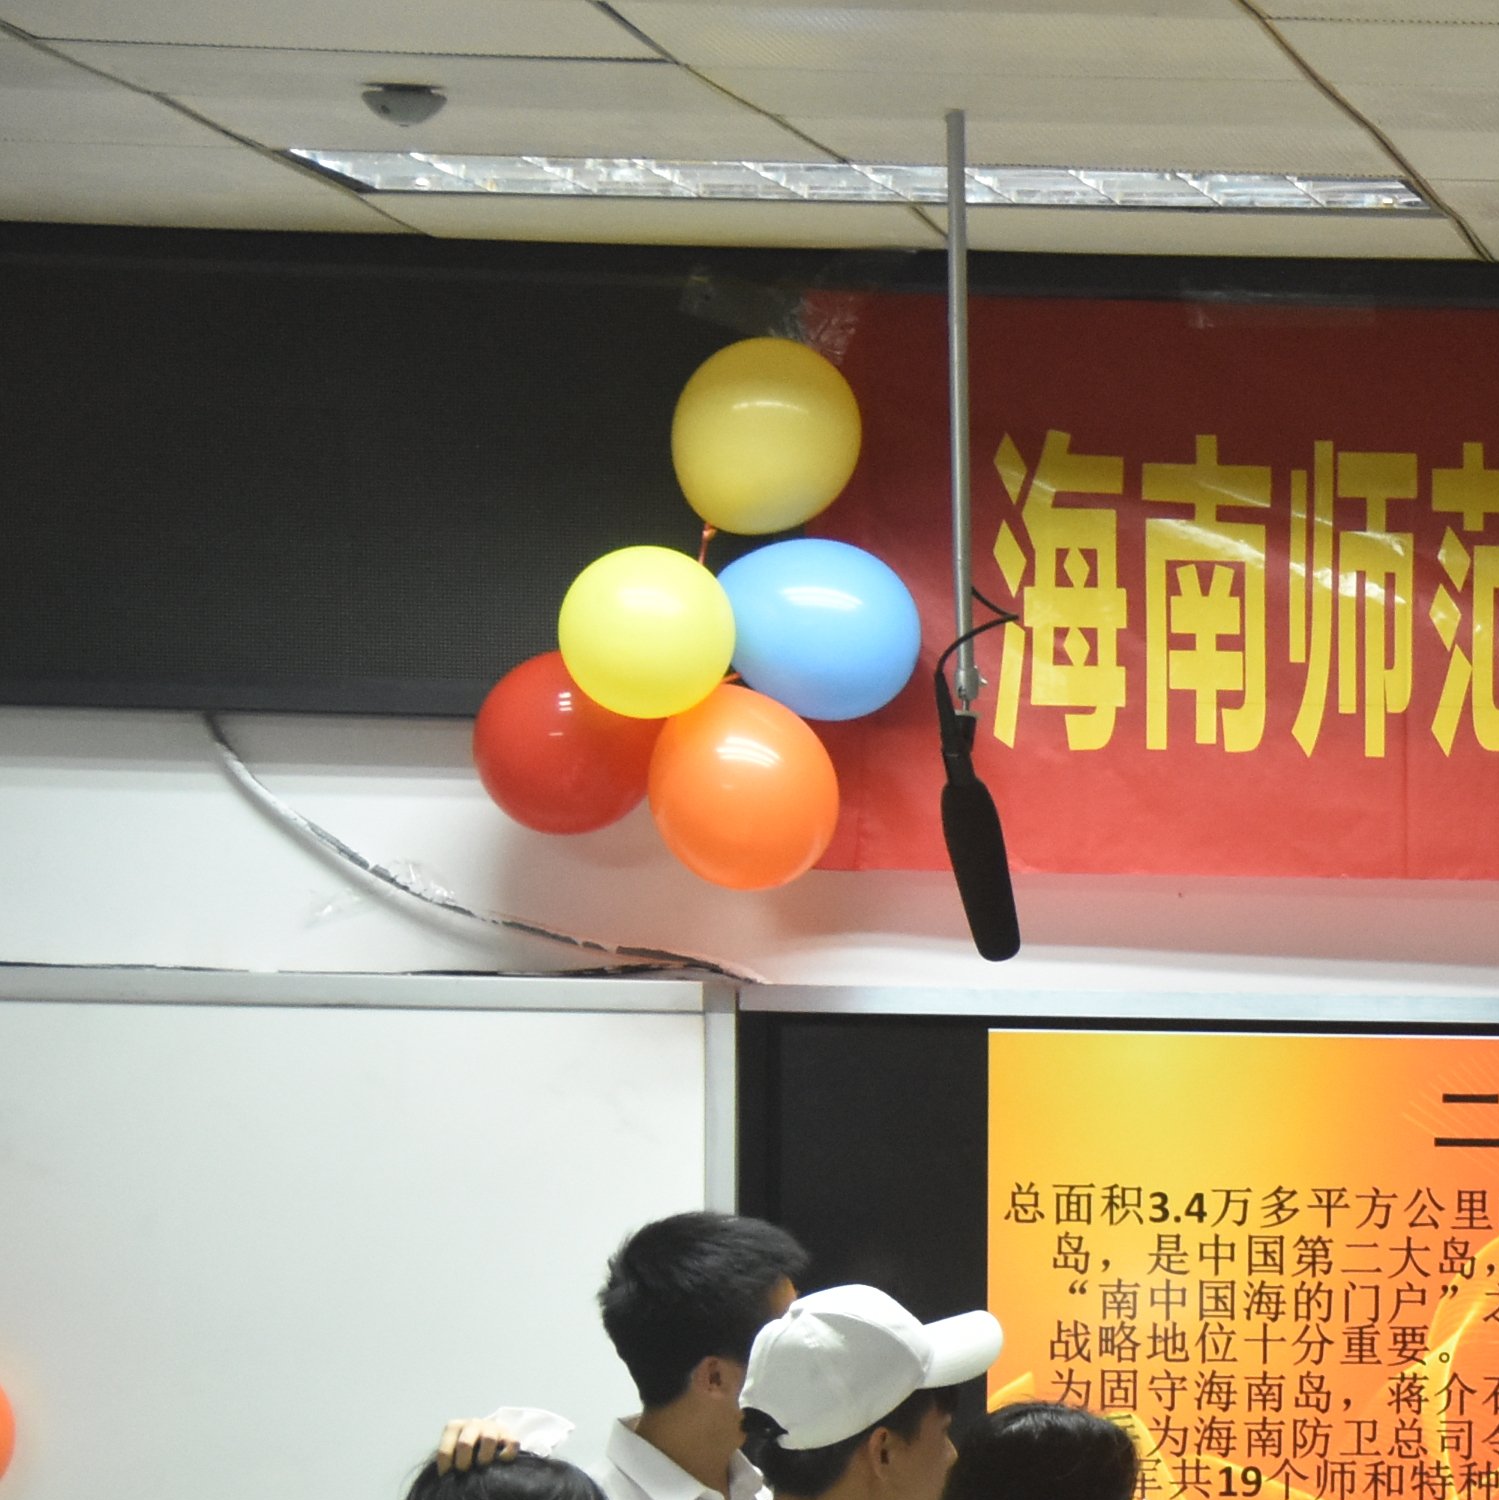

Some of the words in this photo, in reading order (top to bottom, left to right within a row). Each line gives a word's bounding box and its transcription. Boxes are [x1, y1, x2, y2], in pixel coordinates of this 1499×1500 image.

[1050, 1323, 1456, 1366] 战略地位十分重要。
